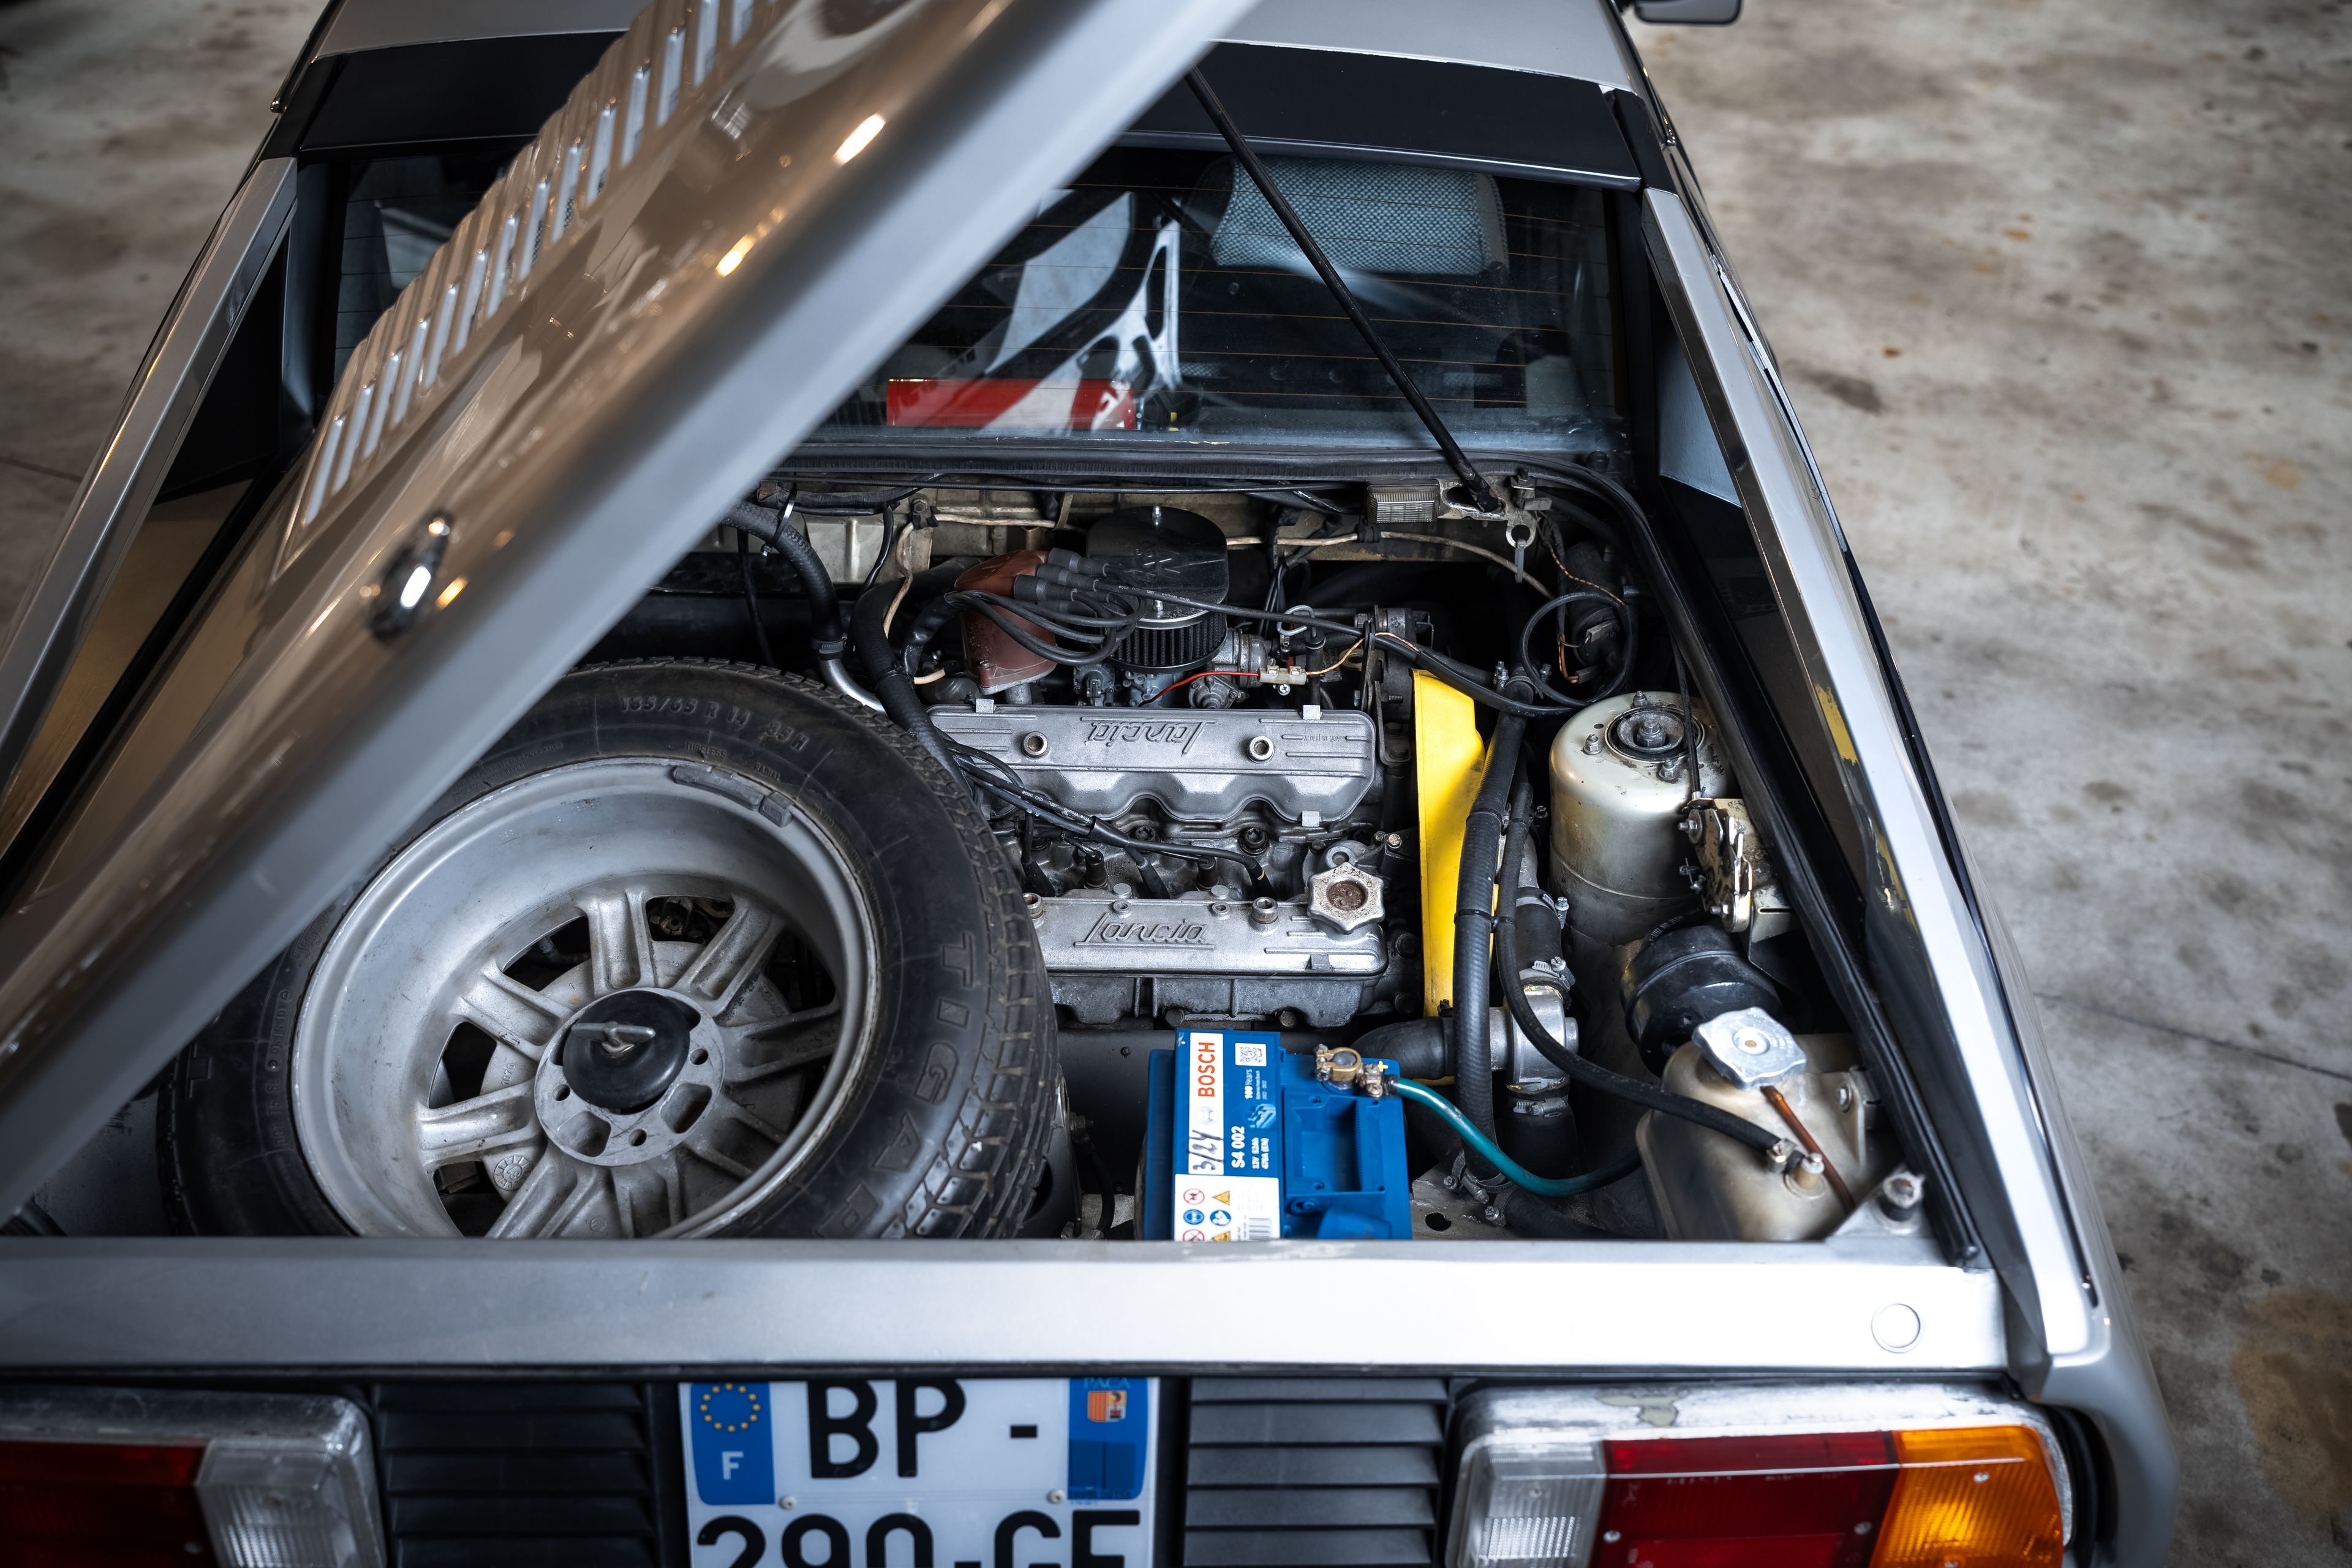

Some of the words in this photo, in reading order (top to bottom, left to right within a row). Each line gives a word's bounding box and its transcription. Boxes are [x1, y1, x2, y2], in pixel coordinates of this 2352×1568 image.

[685, 742, 727, 758] TUBELESS
[1080, 717, 1216, 755] Lancia
[754, 763, 781, 782] RADIAL
[1073, 912, 1215, 949] Lancia
[1198, 1042, 1215, 1098] BOSCH
[1231, 1126, 1245, 1149] 002
[1231, 1151, 1245, 1169] S4
[806, 1379, 967, 1479] BP
[722, 1451, 744, 1480] F
